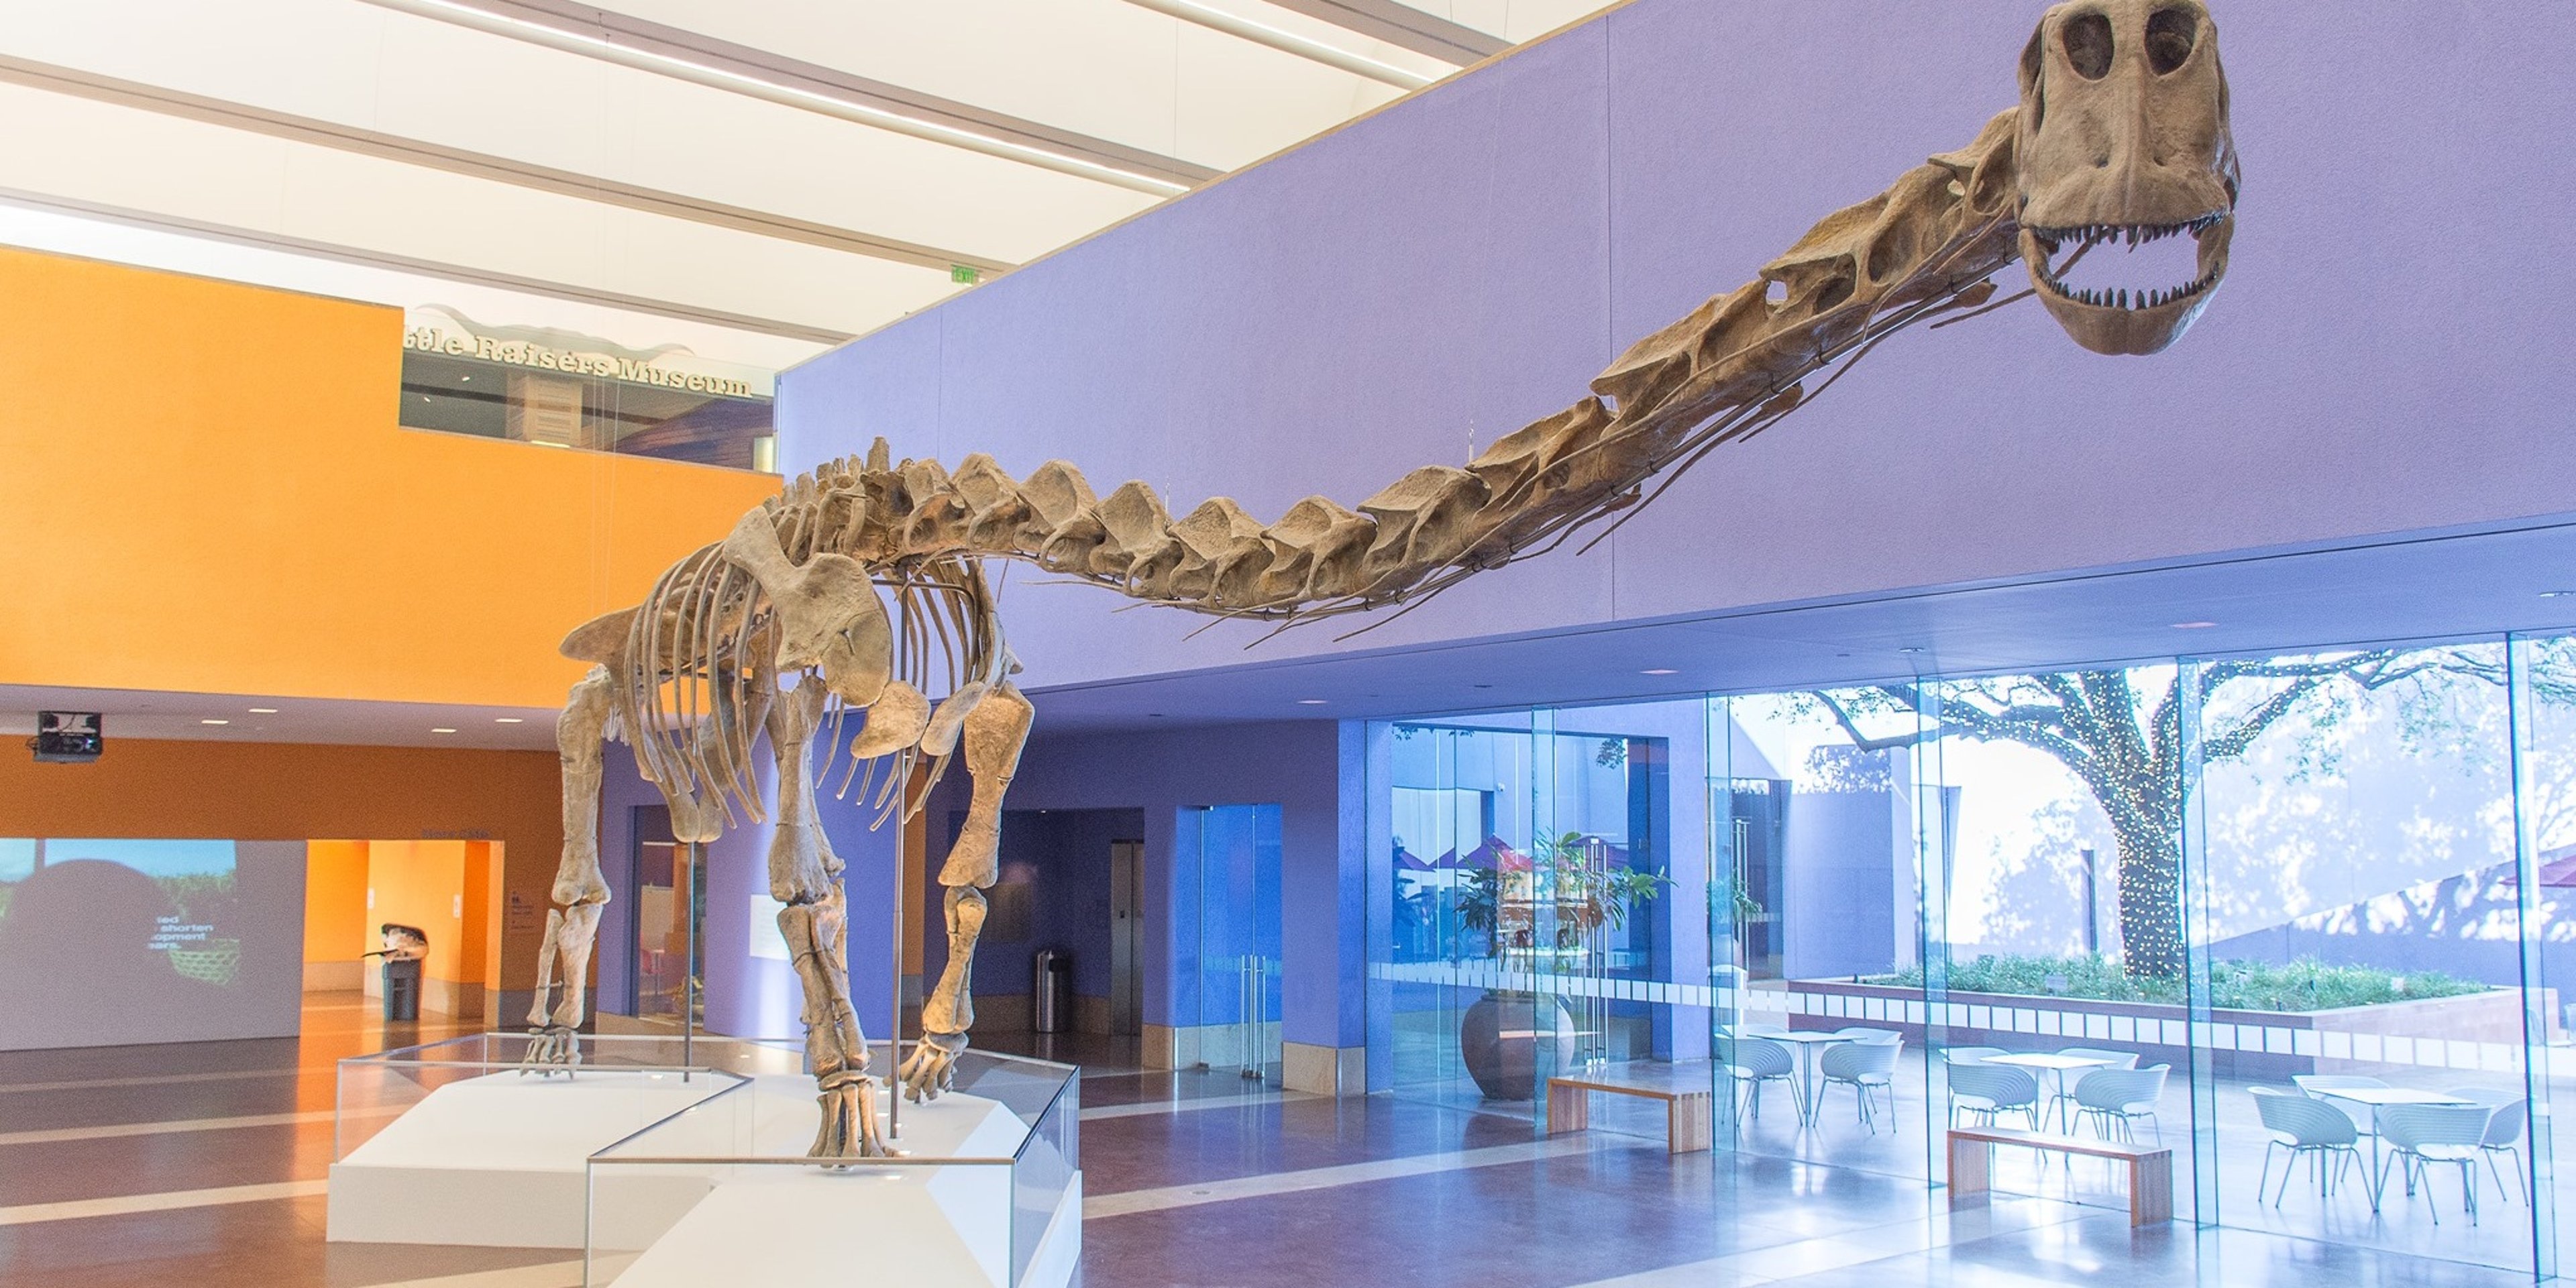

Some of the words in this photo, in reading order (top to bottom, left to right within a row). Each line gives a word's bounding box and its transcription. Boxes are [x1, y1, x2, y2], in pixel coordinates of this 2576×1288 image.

[403, 326, 464, 356] ttle
[474, 335, 609, 377] Raisers
[618, 356, 753, 398] Museum
[160, 924, 214, 932] shorten
